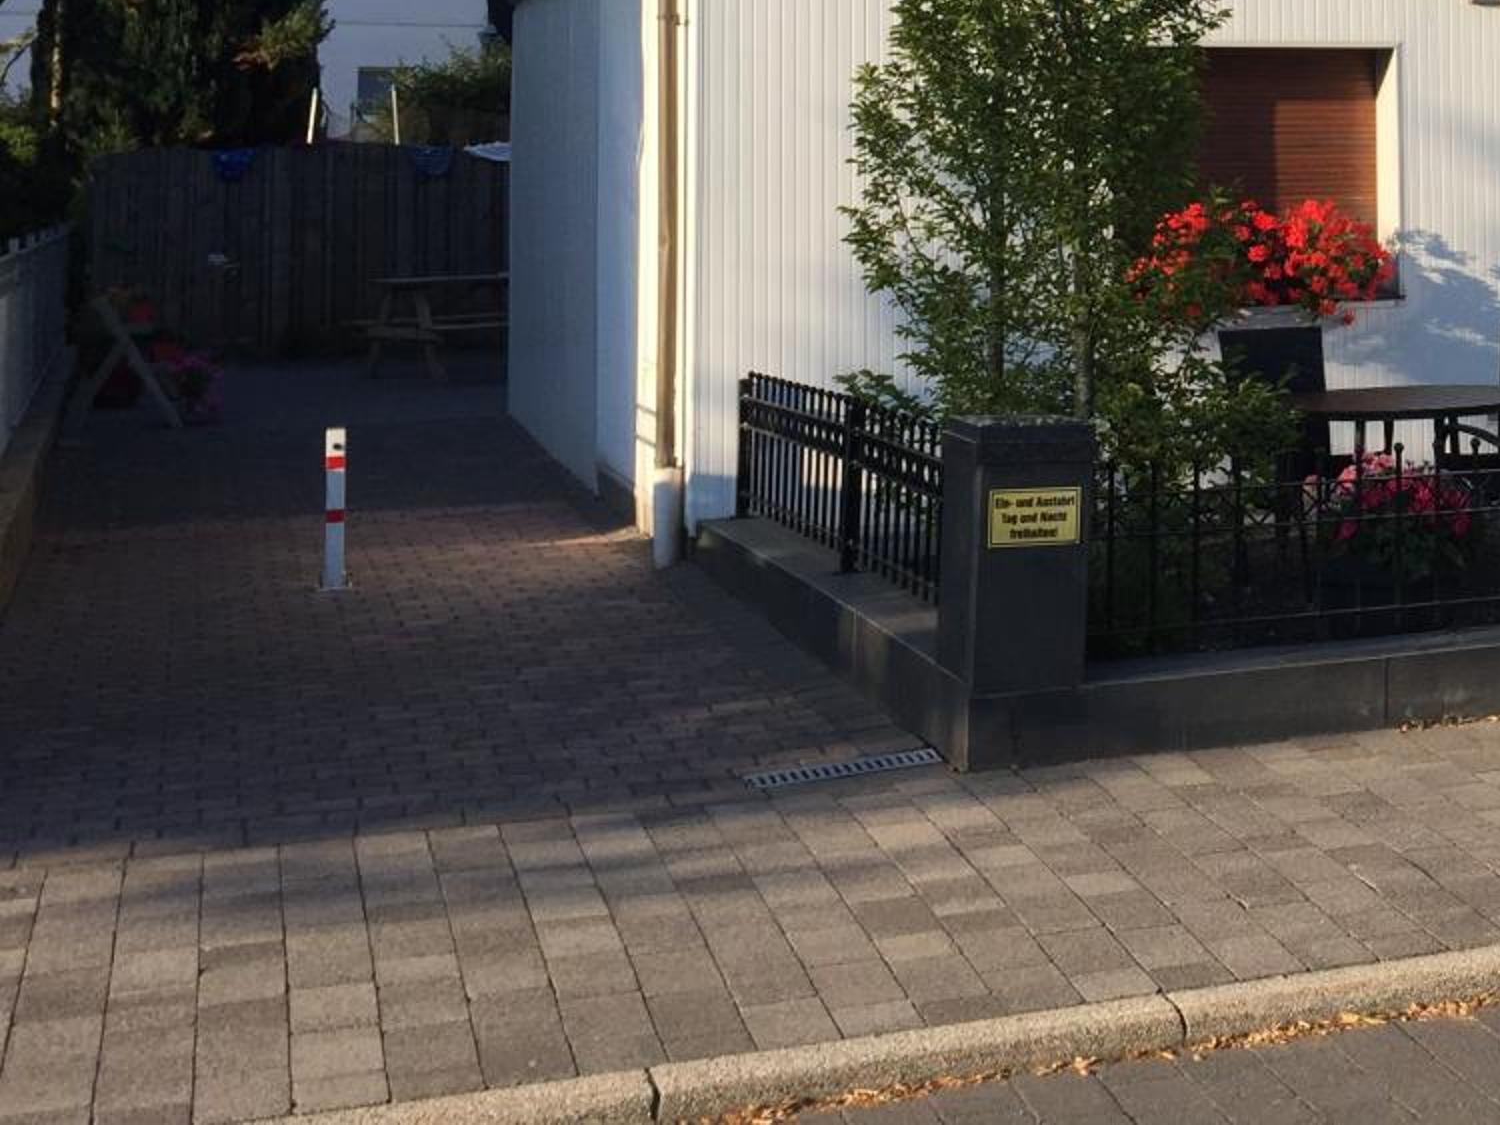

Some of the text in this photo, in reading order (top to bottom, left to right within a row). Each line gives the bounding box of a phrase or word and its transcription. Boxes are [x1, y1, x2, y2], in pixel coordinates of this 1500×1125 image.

[1016, 496, 1034, 508] und
[1036, 495, 1075, 507] Ausfahrt
[1002, 511, 1067, 525] Tag und Nacht
